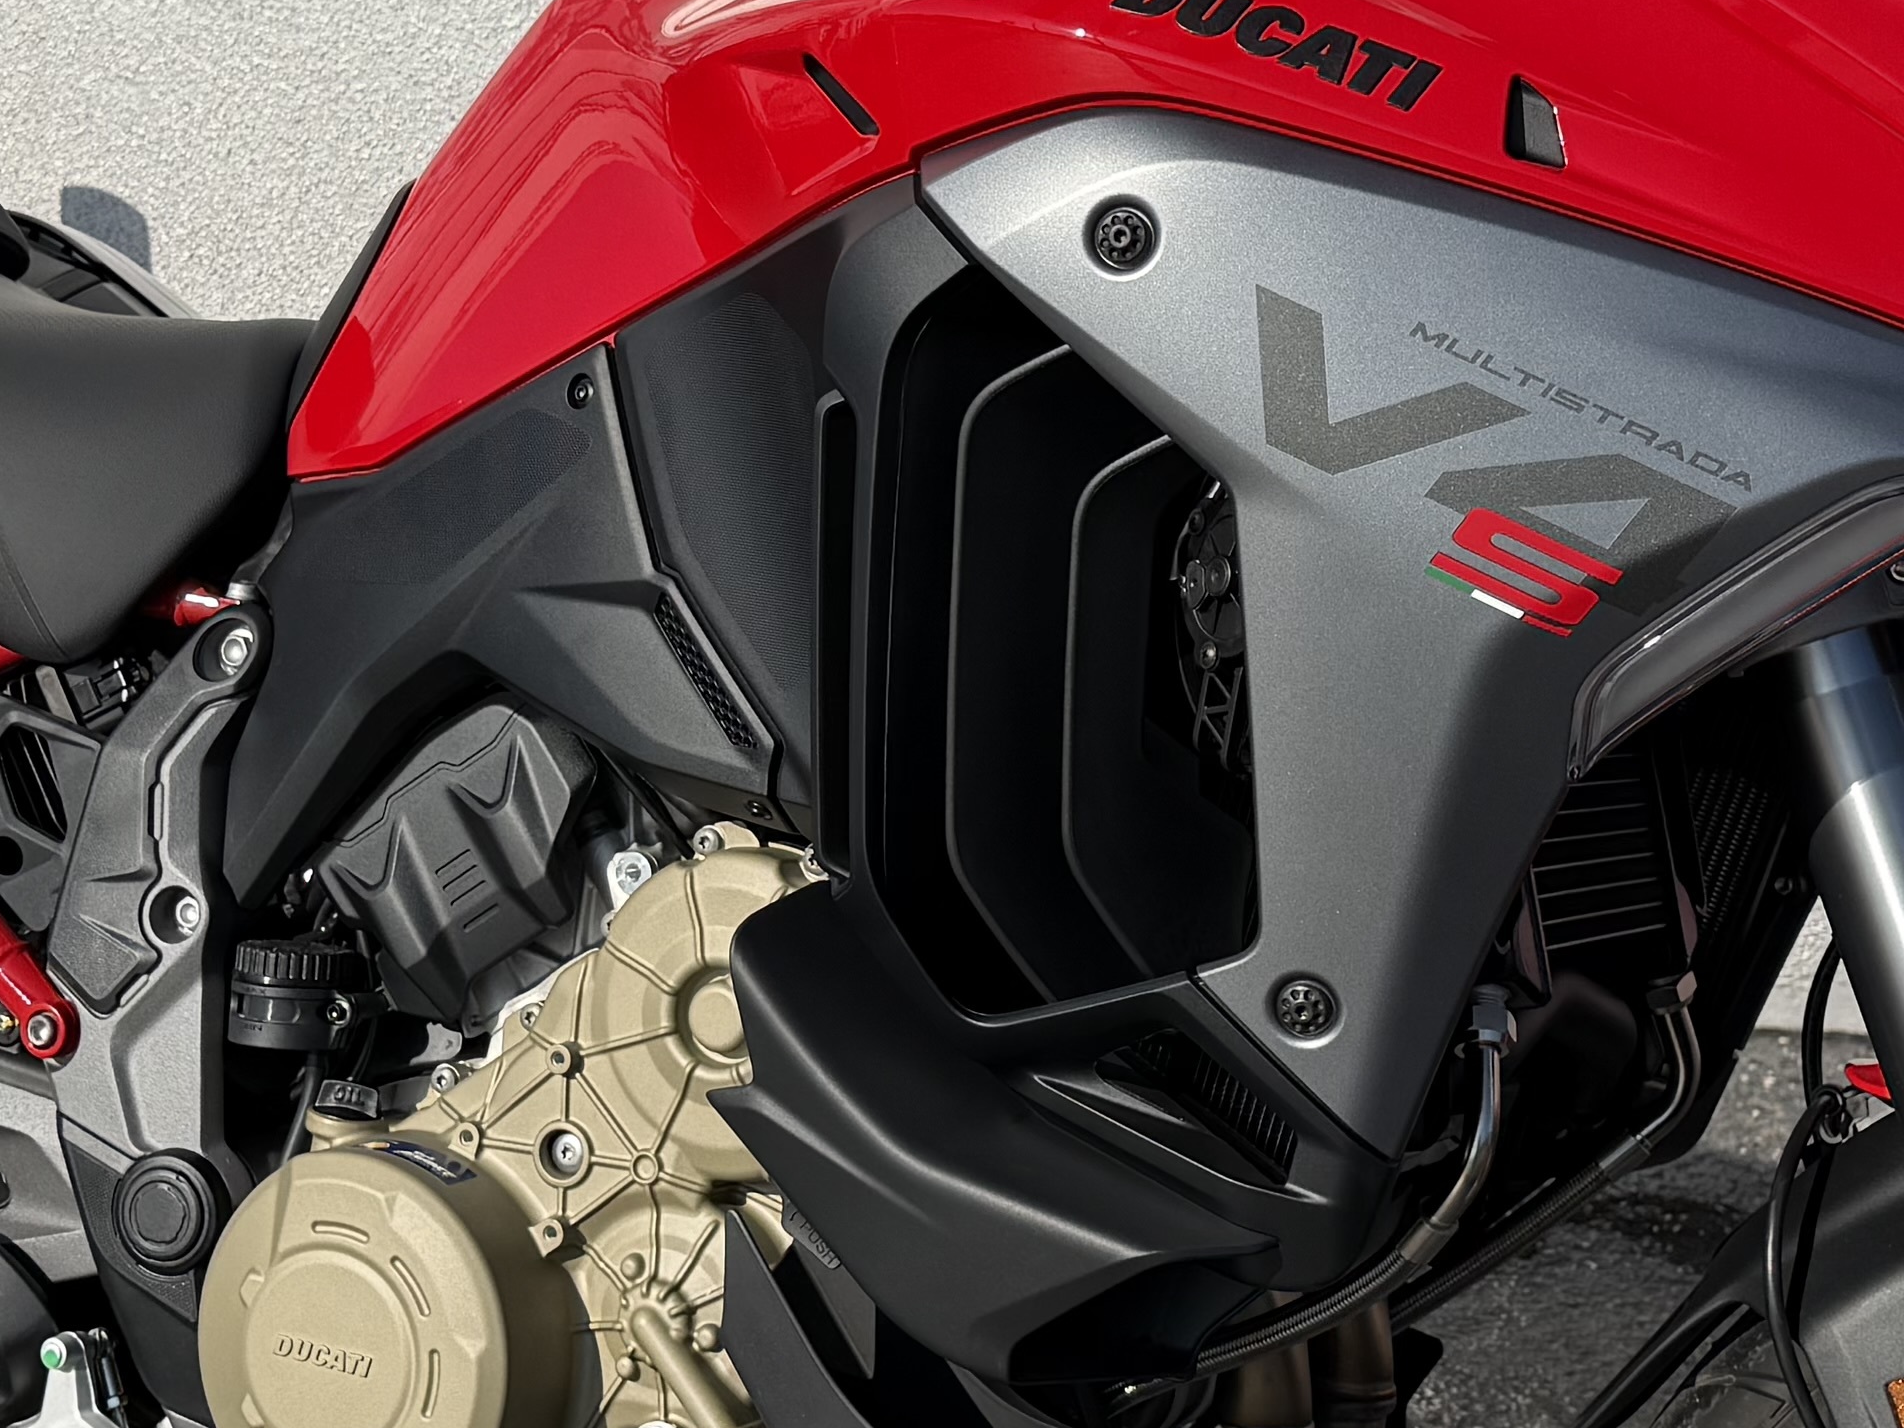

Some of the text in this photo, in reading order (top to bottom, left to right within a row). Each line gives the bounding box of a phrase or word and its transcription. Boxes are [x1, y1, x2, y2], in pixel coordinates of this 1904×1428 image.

[1408, 321, 1752, 491] MULTISTRADA
[333, 1086, 366, 1106] OIL
[800, 1222, 842, 1266] PUSH
[273, 1332, 373, 1379] DUCATI
